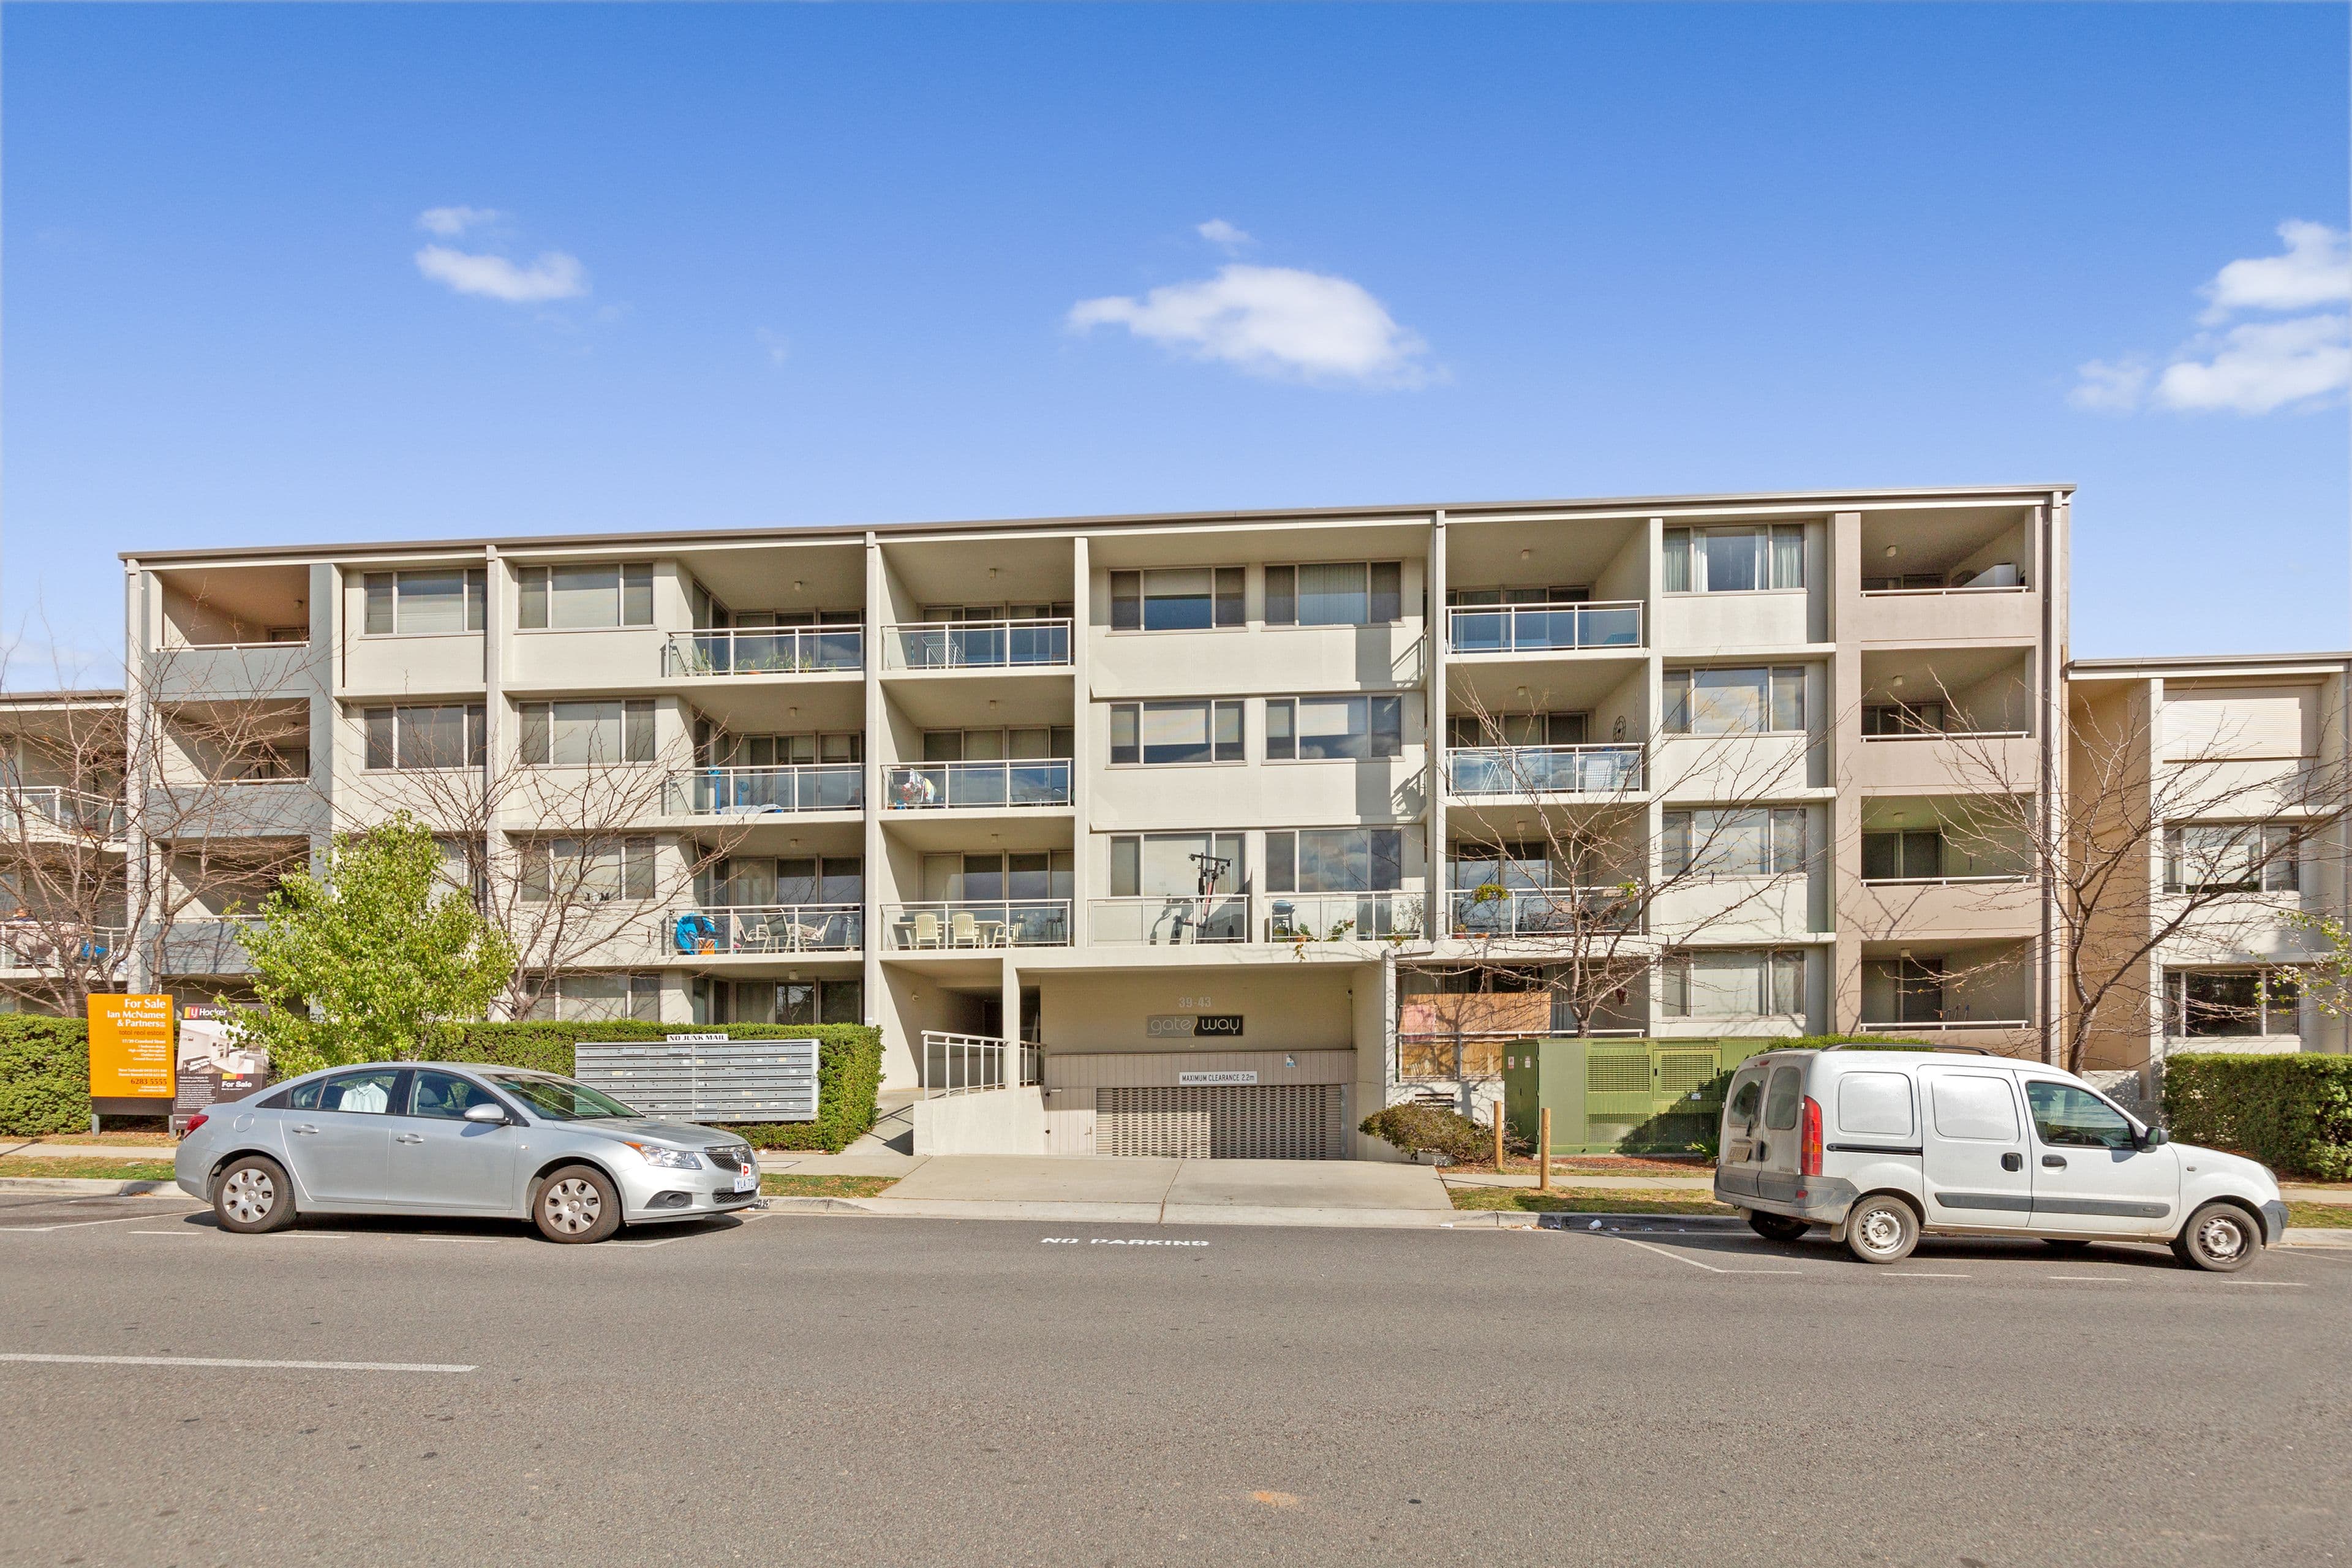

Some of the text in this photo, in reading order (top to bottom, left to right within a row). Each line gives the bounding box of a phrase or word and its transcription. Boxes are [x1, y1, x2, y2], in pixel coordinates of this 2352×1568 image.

[124, 998, 166, 1009] For Sale
[1178, 997, 1212, 1008] 39-43
[1148, 1017, 1240, 1036] gate way
[743, 1165, 749, 1177] P
